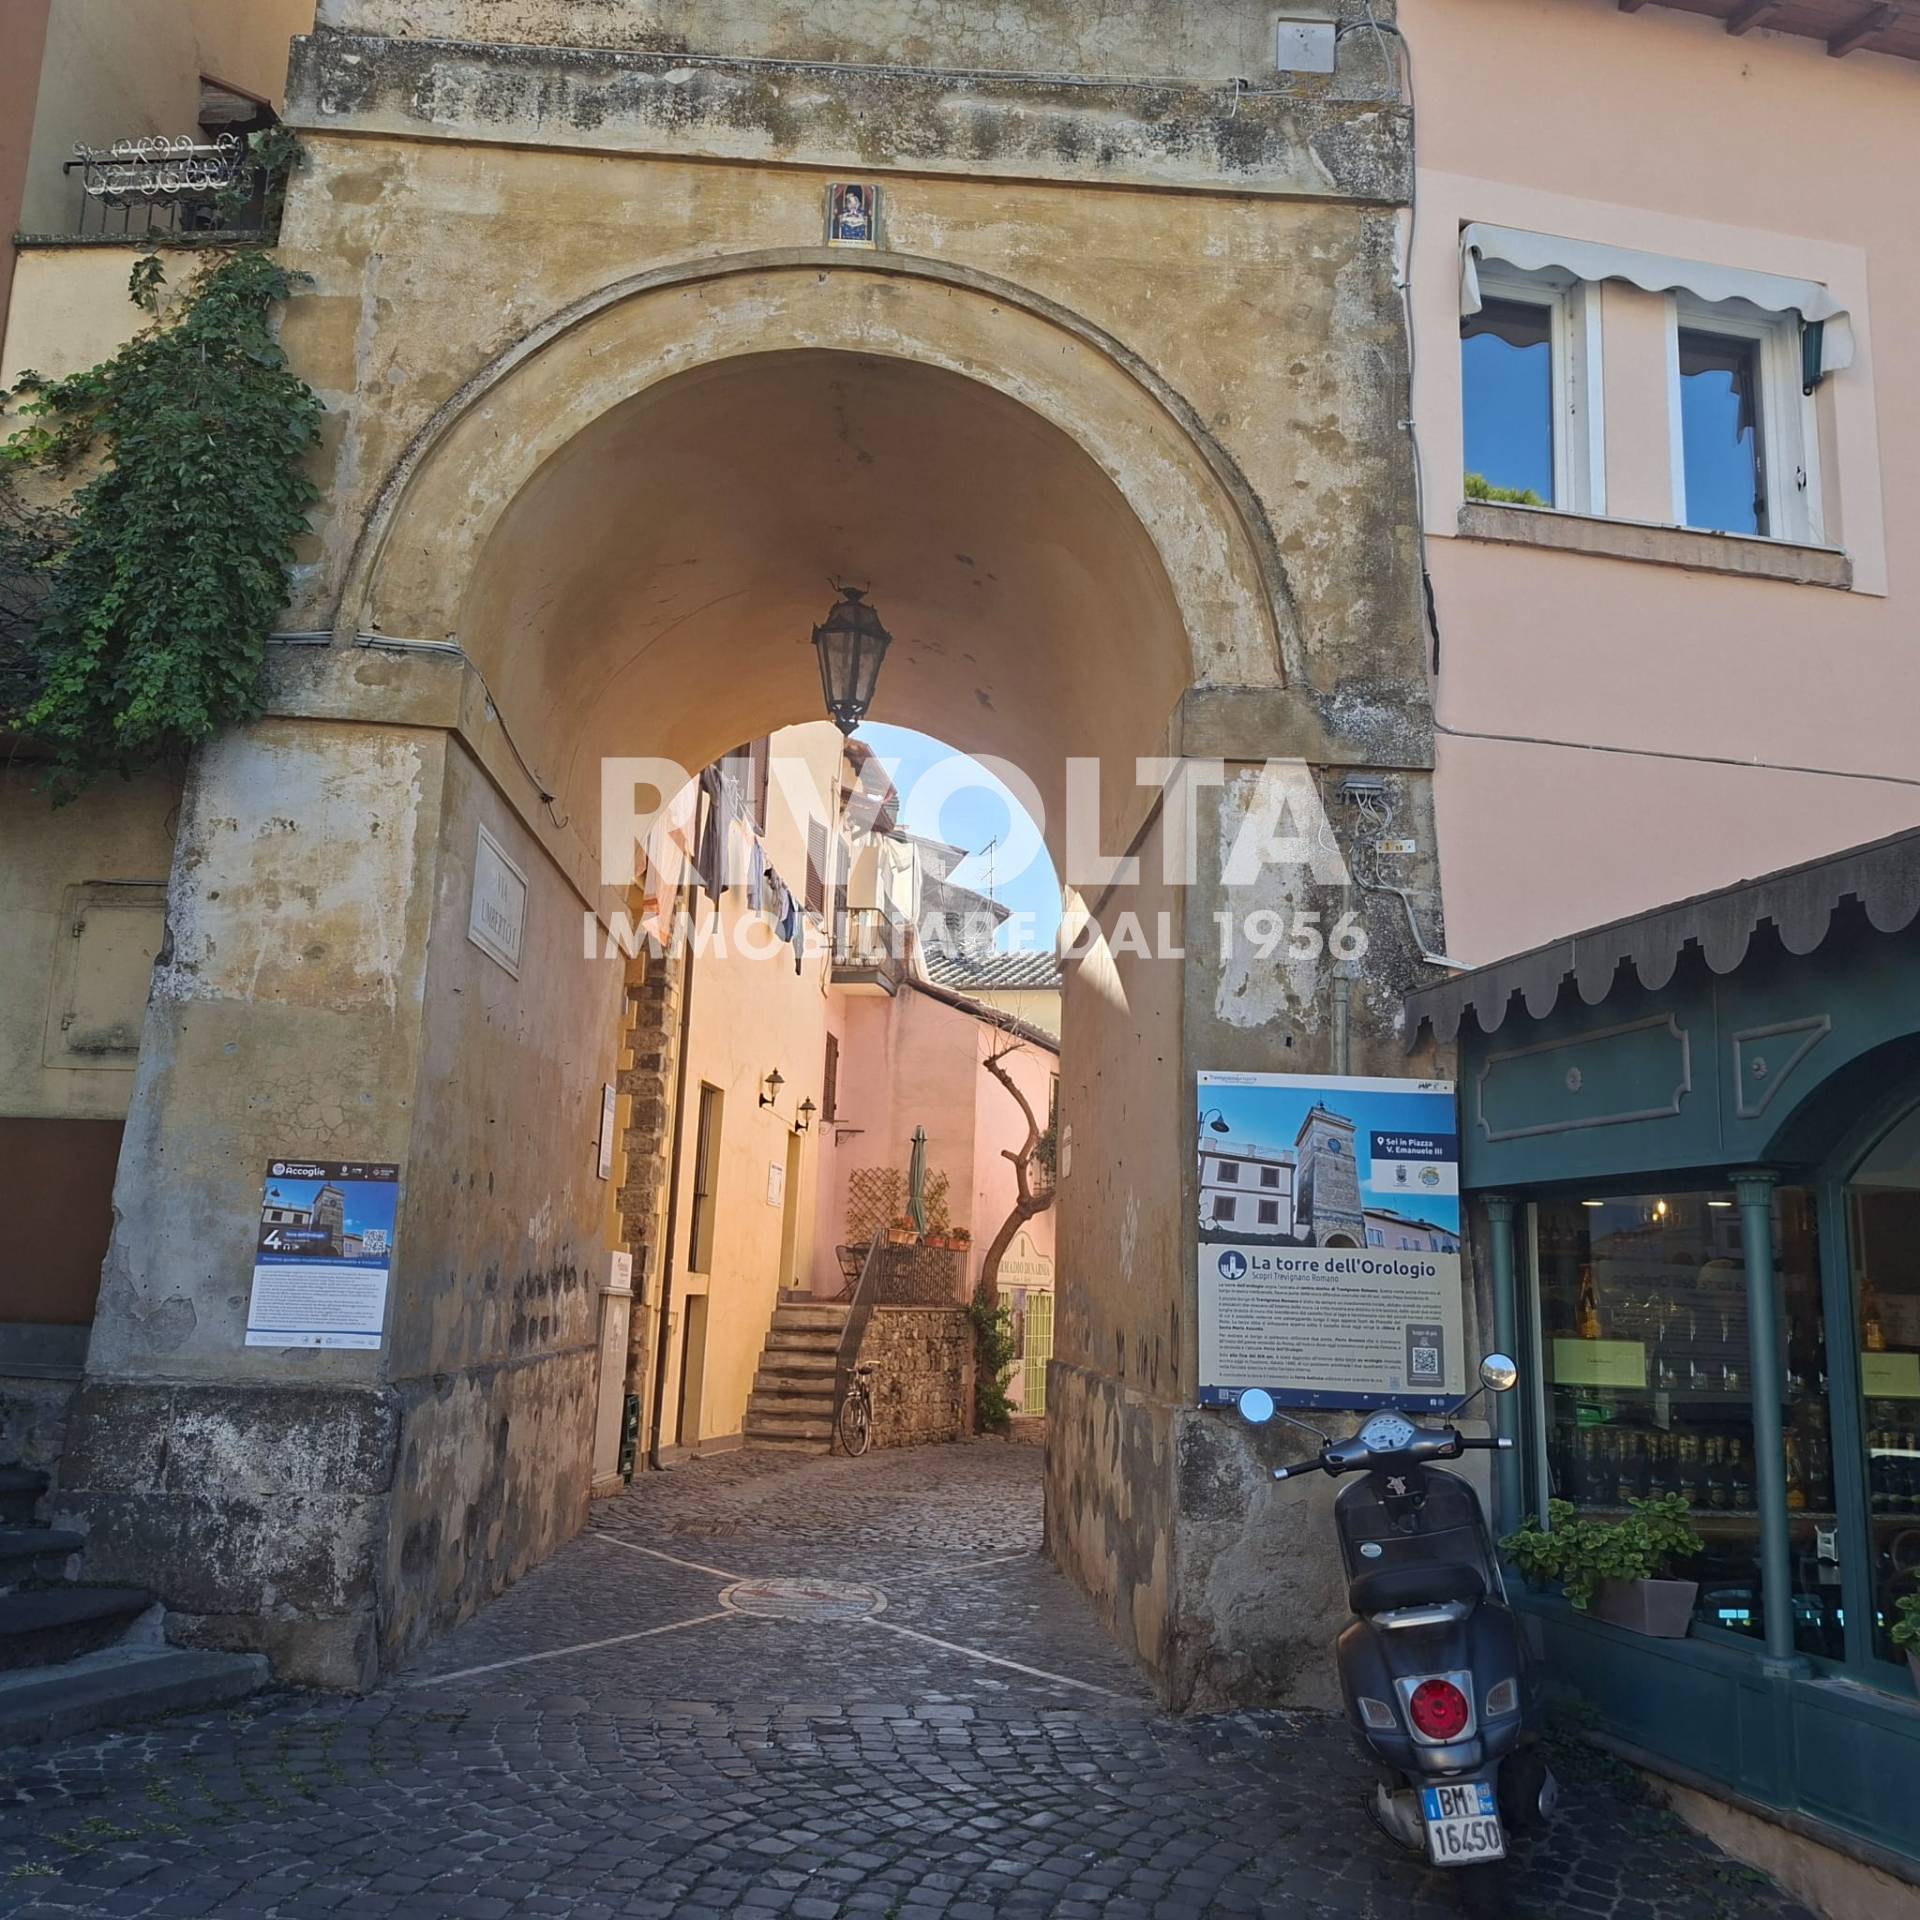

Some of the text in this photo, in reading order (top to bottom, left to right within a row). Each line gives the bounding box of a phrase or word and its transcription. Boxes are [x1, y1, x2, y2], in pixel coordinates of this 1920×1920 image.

[1395, 1147, 1433, 1155] Emanuele
[1408, 1139, 1433, 1147] Piazza
[285, 1167, 326, 1177] Accoglie
[263, 1229, 282, 1250] 4
[1252, 1256, 1436, 1279] La torre dell'Orologio
[1252, 1271, 1339, 1283] Scopri Trevignano Romano
[1438, 1786, 1469, 1816] BM
[1435, 1821, 1500, 1855] 16450
